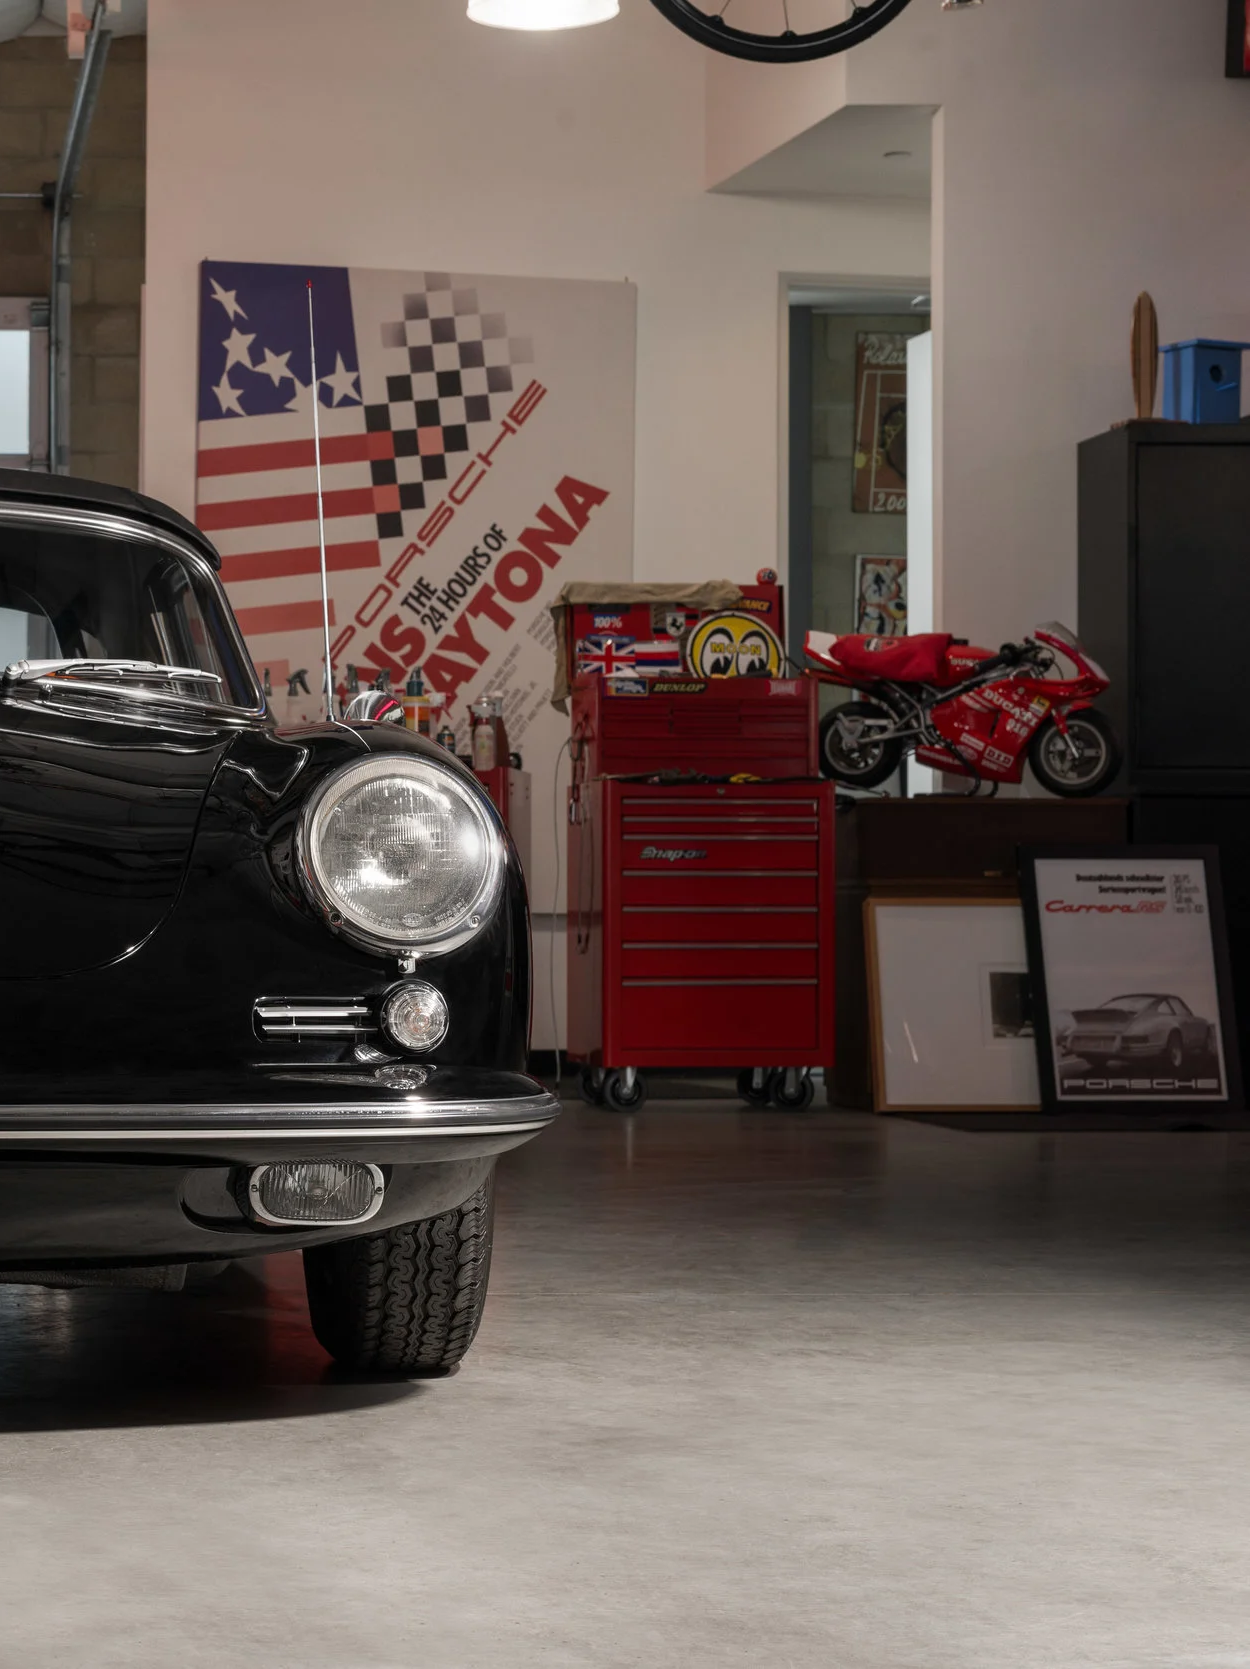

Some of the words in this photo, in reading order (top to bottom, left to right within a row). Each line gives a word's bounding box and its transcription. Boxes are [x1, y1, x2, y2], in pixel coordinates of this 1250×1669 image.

[322, 379, 548, 671] PORSCHE
[420, 605, 449, 635] 24
[436, 545, 492, 613] HOURS
[483, 523, 507, 552] OF
[759, 568, 775, 581] 76
[400, 576, 438, 616] THE
[419, 475, 610, 720] AYTONA
[594, 615, 622, 628] 100%
[710, 642, 762, 655] MOON
[653, 683, 706, 693] DUNLOP
[982, 688, 1039, 727] DUCATI
[639, 845, 708, 862] Snap-on
[1045, 900, 1135, 914] Carrera
[1063, 1078, 1219, 1090] PORSCHE
